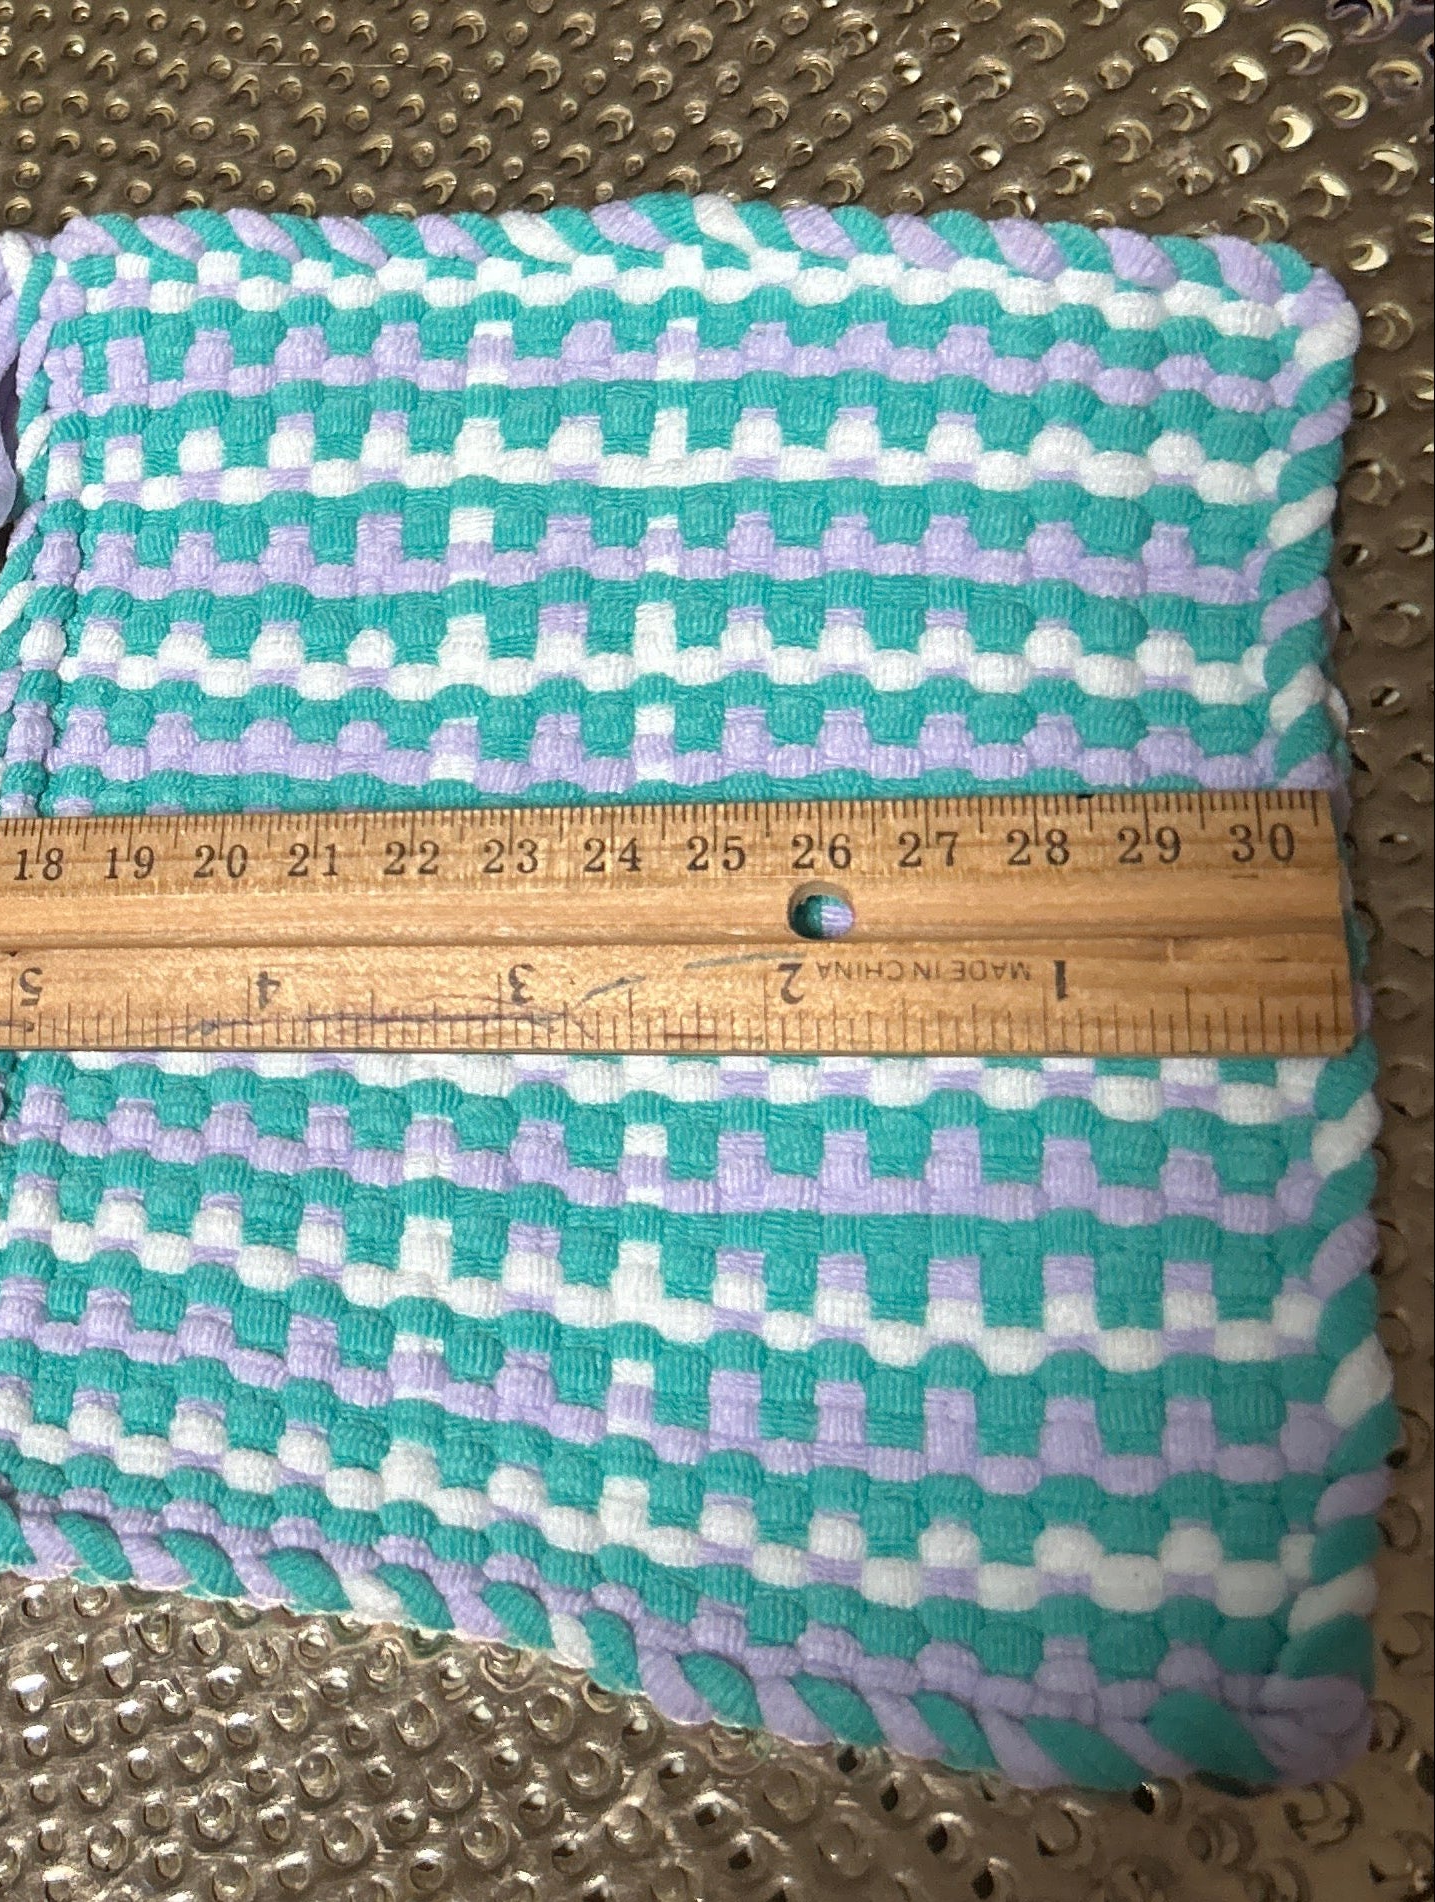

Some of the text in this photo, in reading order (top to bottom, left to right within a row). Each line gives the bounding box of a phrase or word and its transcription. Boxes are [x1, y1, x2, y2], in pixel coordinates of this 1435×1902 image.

[13, 847, 64, 882] 18
[103, 846, 155, 880] 19
[193, 844, 248, 879] 20
[287, 842, 339, 877] 21
[383, 840, 441, 876] 22
[482, 838, 539, 874] 23
[583, 837, 643, 873] 24
[686, 835, 747, 872] 25
[790, 833, 852, 870] 26
[898, 830, 959, 868] 27
[1006, 828, 1071, 866] 28
[1117, 826, 1182, 864] 29
[1228, 822, 1296, 863] 30
[19, 967, 43, 1007] 5
[255, 971, 281, 1009] 4
[507, 962, 535, 1005] 3
[777, 962, 805, 1005] 2
[816, 960, 1032, 982] MADE IN CHINA
[1053, 959, 1069, 1000] 1
